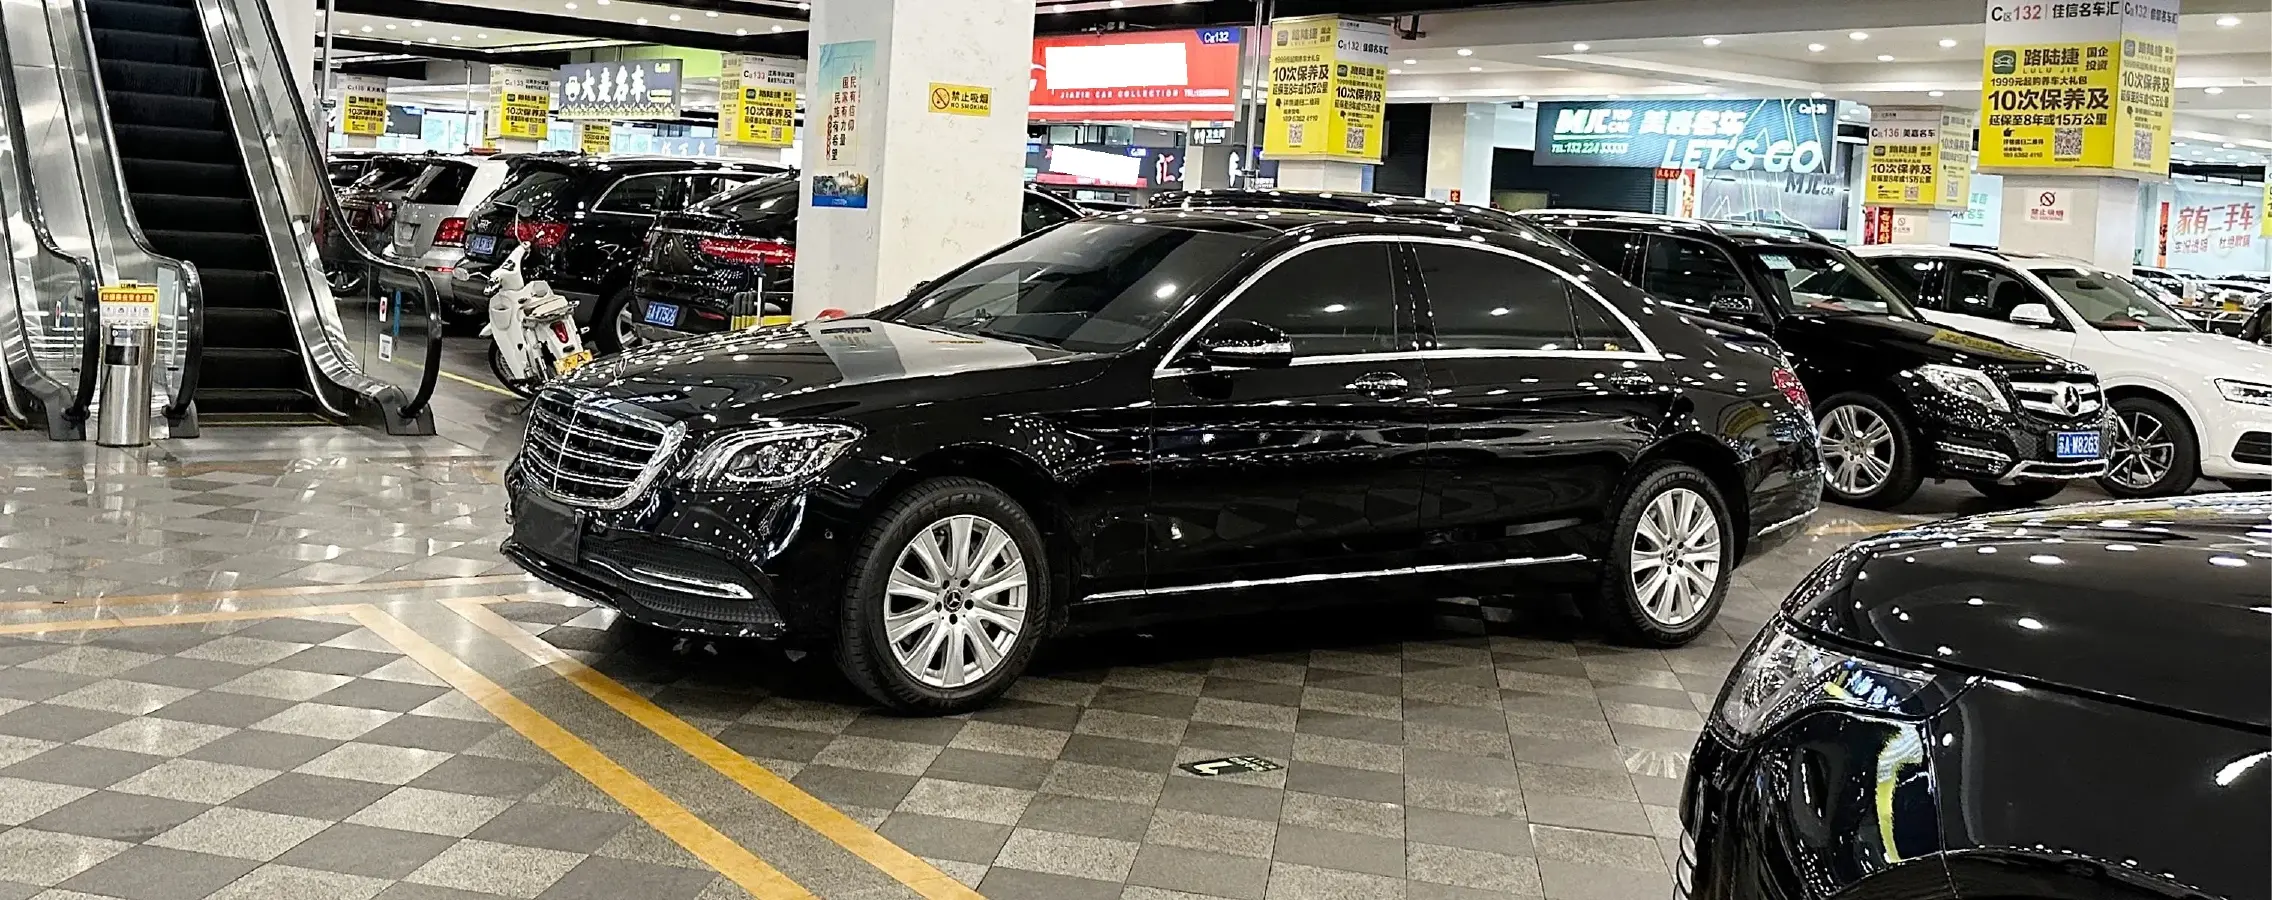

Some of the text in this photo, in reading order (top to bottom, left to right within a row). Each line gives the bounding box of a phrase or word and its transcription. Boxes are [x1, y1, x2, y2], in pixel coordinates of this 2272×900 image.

[2052, 1, 2120, 19] 佳信名车汇
[2023, 47, 2080, 67] 路陆捷
[2086, 46, 2109, 58] 国企
[1272, 64, 1329, 82] 10次保养及
[2085, 60, 2108, 71] 投资
[2122, 71, 2170, 93] 10次保养及
[951, 91, 989, 104] 禁止吸烟
[1335, 85, 1381, 102] 10次保养及
[1987, 87, 2109, 111] 10次保养及
[1989, 113, 2107, 126] 延保至8年或15万公里
[1660, 138, 1821, 174] LET'S GO
[1870, 164, 1932, 175] 10次保养及
[2176, 202, 2256, 236] 家有二手车
